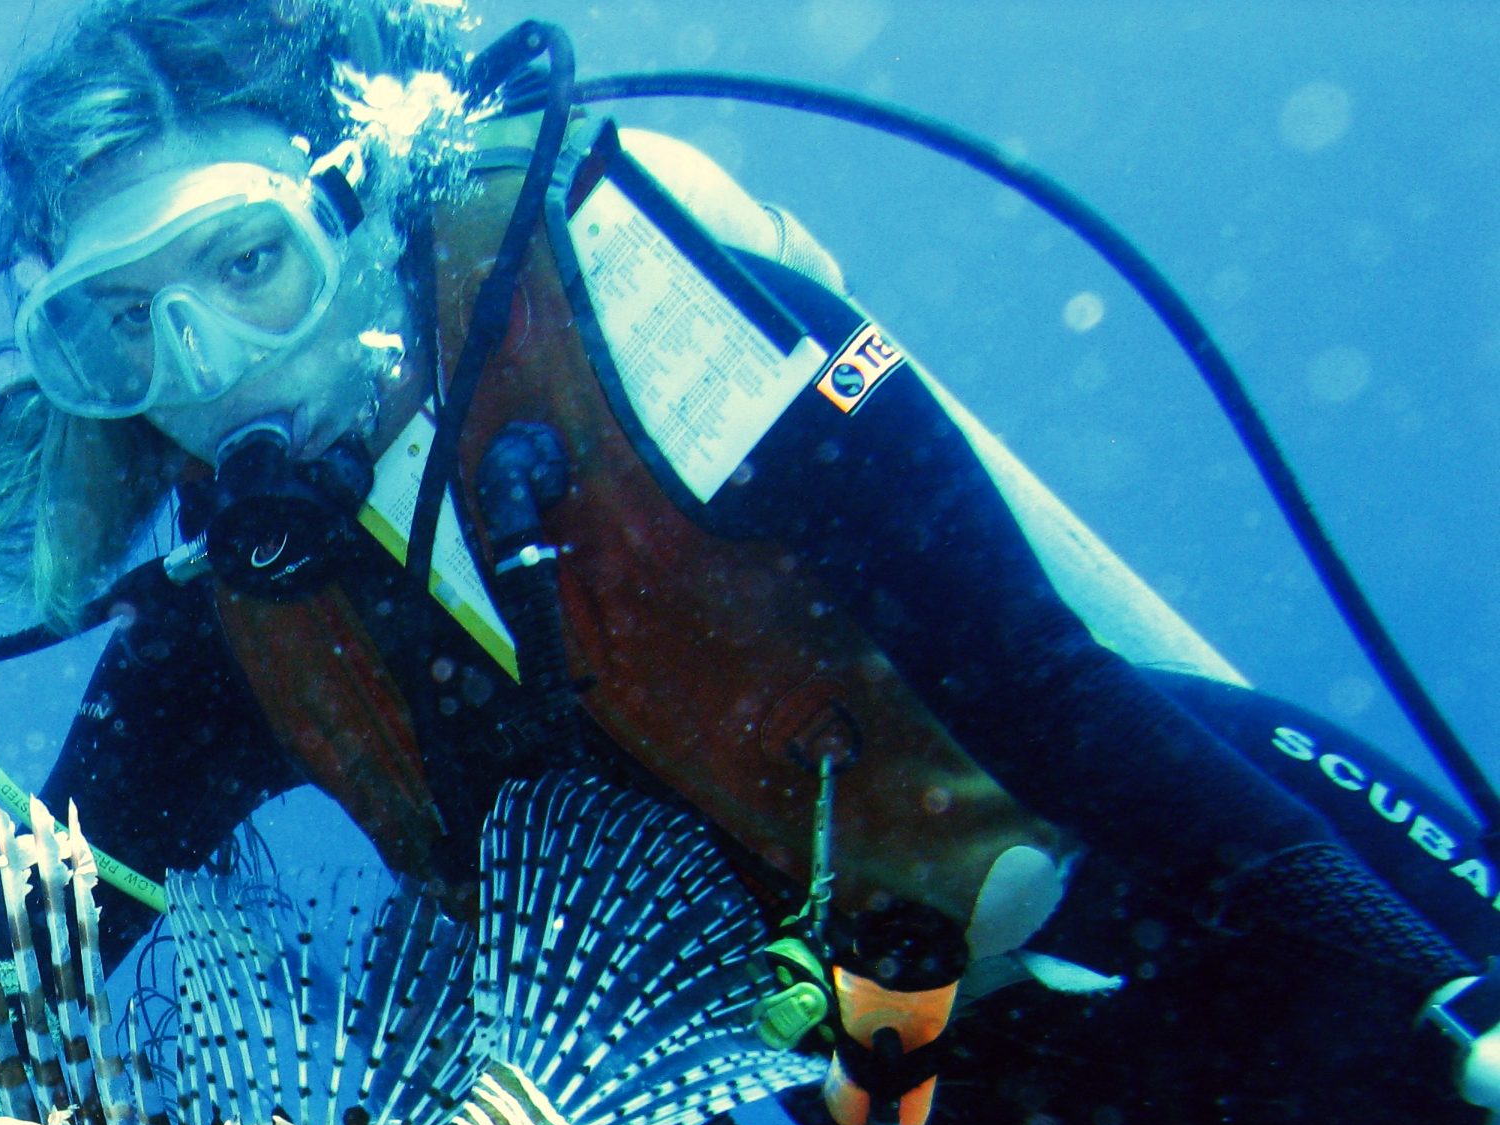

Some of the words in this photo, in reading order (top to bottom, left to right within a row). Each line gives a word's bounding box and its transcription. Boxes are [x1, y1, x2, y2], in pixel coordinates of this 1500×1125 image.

[1, 784, 30, 817] STED
[1272, 727, 1500, 912] SCUBA
[124, 872, 157, 896] LOW
